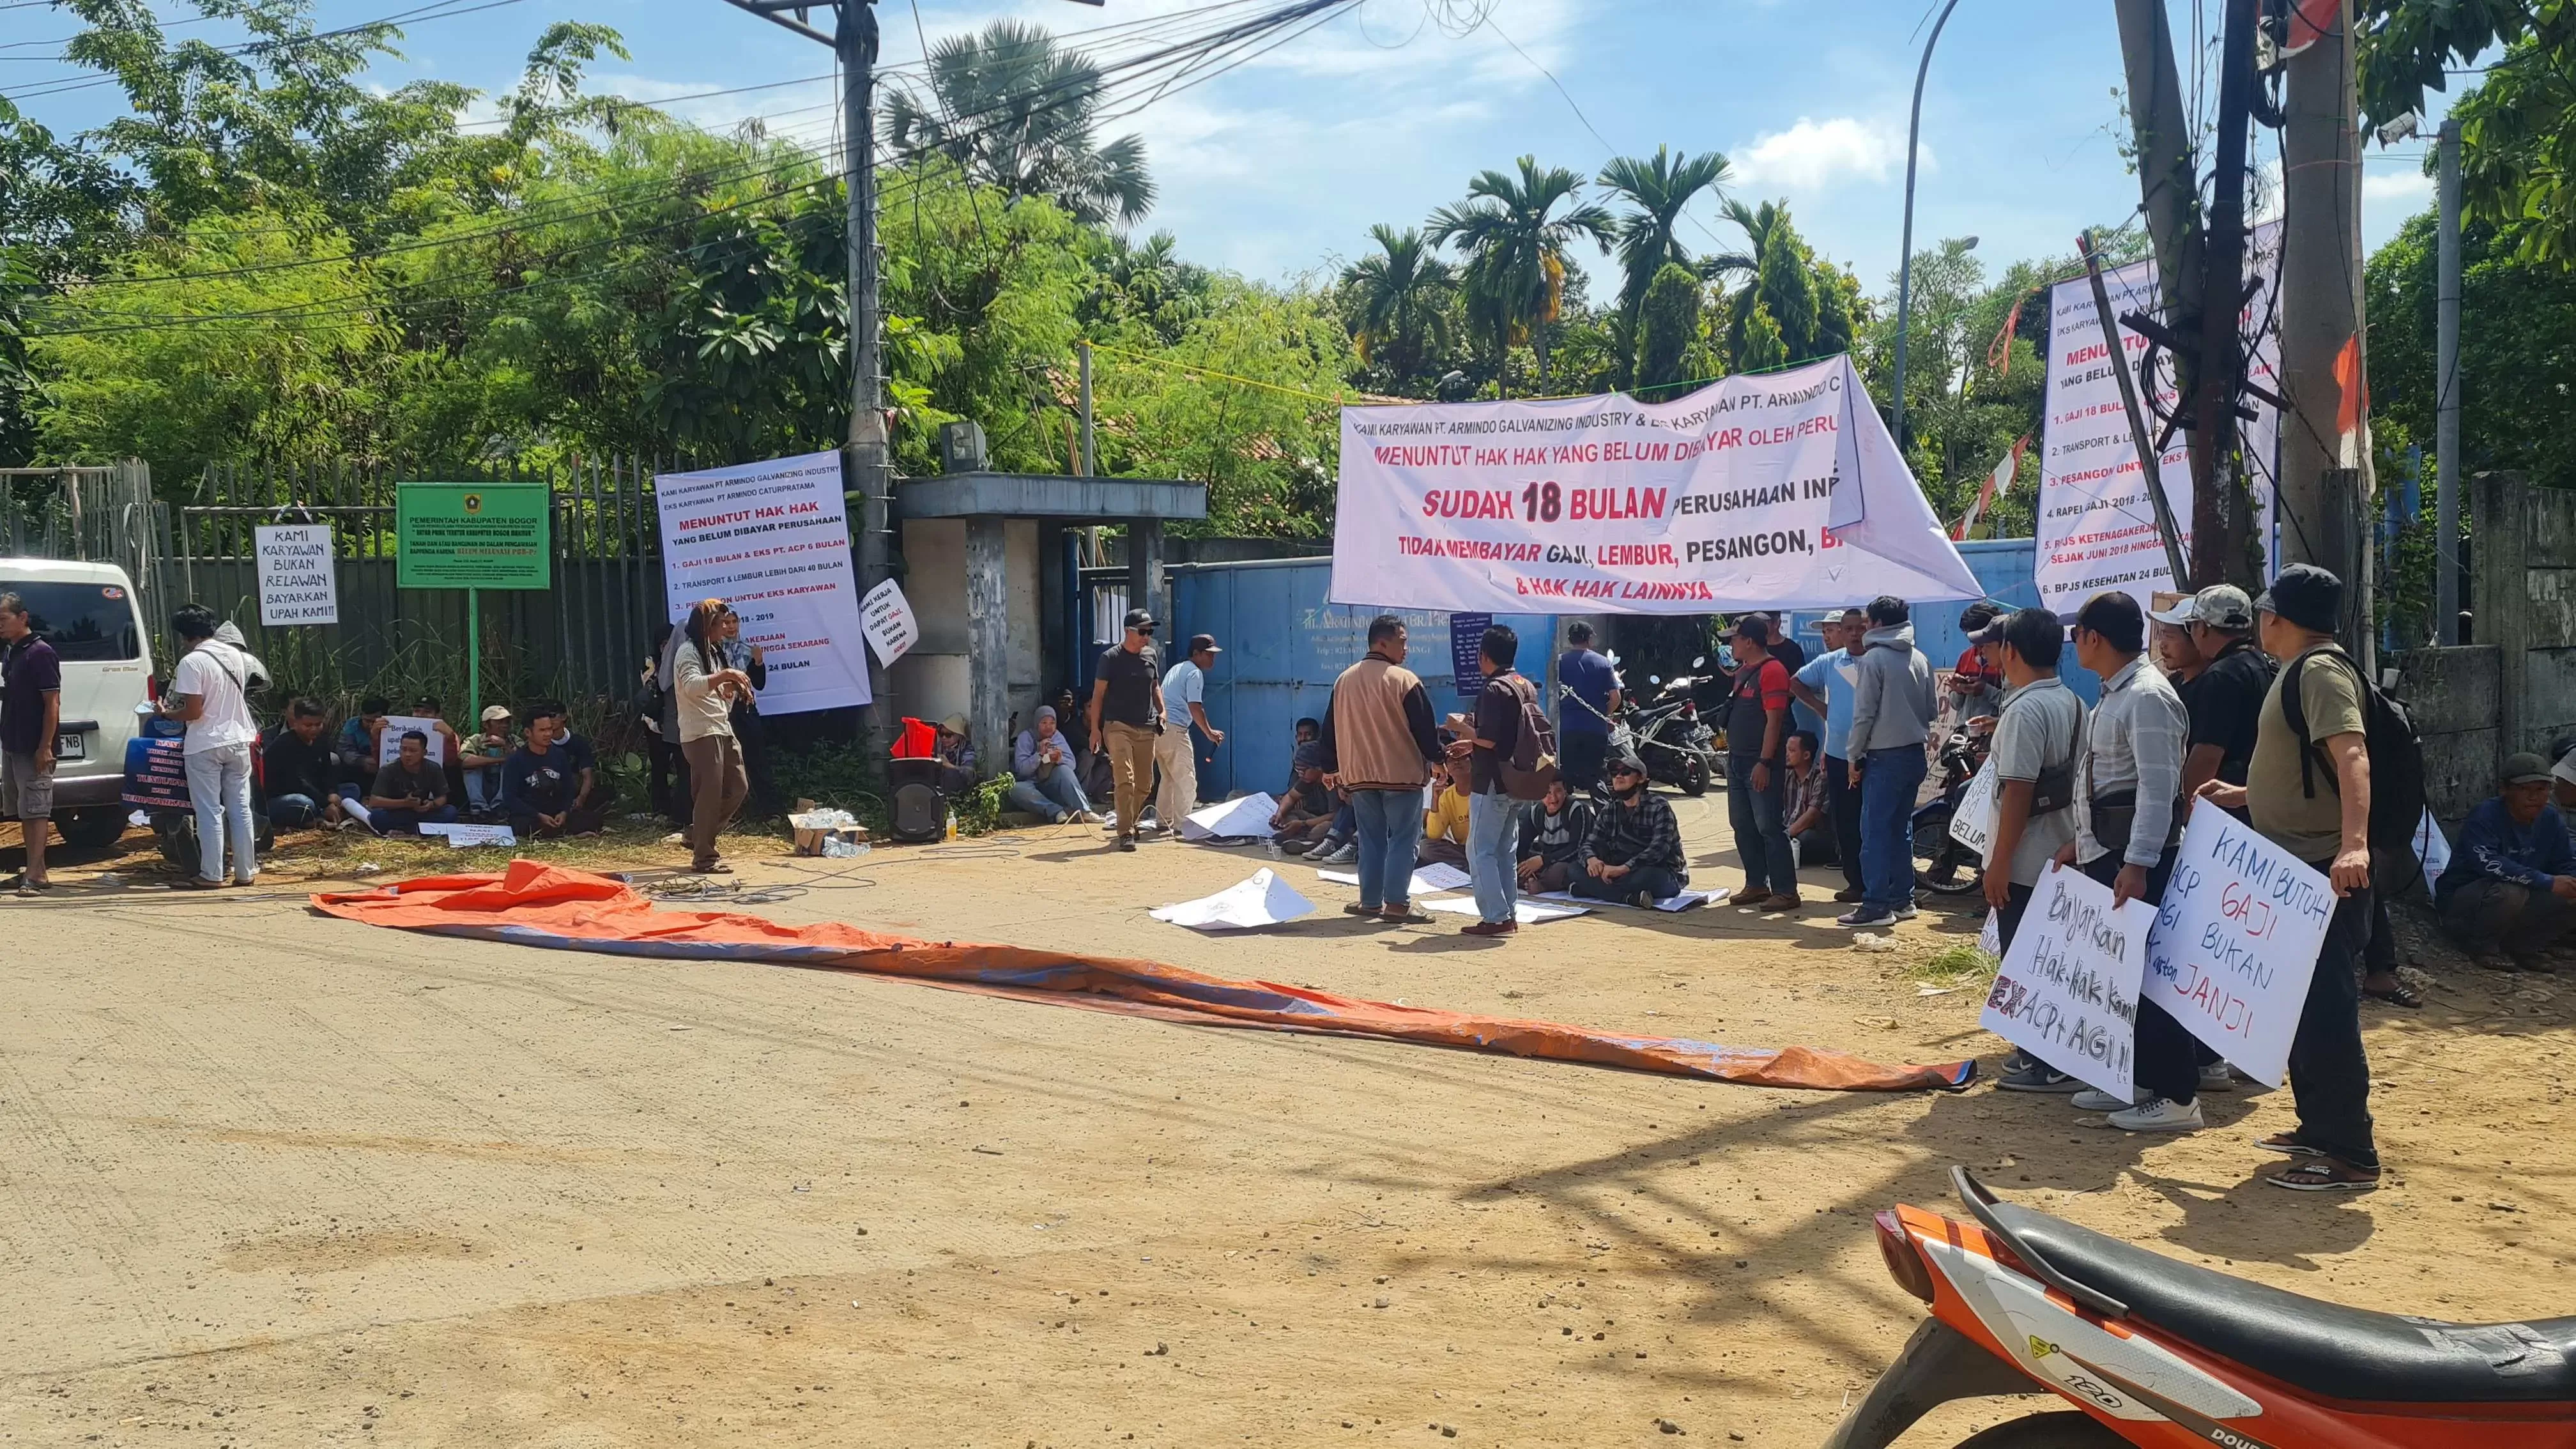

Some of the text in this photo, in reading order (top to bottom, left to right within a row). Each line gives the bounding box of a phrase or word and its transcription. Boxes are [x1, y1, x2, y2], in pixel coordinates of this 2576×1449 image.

[2066, 334, 2150, 366] MENUTU
[2061, 365, 2115, 390] YANG BELU
[1353, 420, 1378, 436] KAMI
[1379, 422, 1433, 436] KARYAWAN
[1436, 422, 1446, 434] PT.
[1448, 420, 1497, 435] ARMINDO
[1499, 417, 1573, 433] GALVANIZING
[1575, 413, 1632, 430] INDUSTRY
[1636, 413, 1646, 427] &
[1741, 395, 1763, 410] PT.
[1767, 381, 1827, 408] ARMINDO
[2054, 406, 2096, 425] 1. GAJI 18
[1374, 414, 1839, 467] MENUNTUT HAK HAK YANG BELUM DIBAYAR OLEH PERU
[2051, 434, 2119, 456] 2. TRANSPORT &
[661, 488, 677, 497] KAMI
[678, 484, 714, 495] KARYAWAN
[724, 476, 756, 487] ARMINDO
[757, 470, 804, 482] GALVANIZING
[804, 465, 840, 477] INDUSTRY
[2050, 477, 2058, 487] 3.
[2162, 451, 2181, 465] EKS
[664, 502, 678, 511] EKS
[678, 497, 714, 509] KARYAWAN
[726, 489, 758, 500] ARMINDO
[758, 482, 816, 496] CATURPRATAMA
[1422, 480, 1795, 523] SUDAH 18 BULAN PERUSAHAAN
[2112, 496, 2135, 508] 2018
[679, 501, 820, 531] MENUNTUT HAK HAK
[275, 530, 309, 542] KAMI
[672, 515, 842, 547] YANG BELUM DIBAYAR PERUSAHAAN
[263, 544, 325, 556] KARYAWAN
[682, 558, 702, 569] GAJI
[704, 556, 714, 565] 18
[716, 553, 742, 564] BULAN
[753, 549, 771, 557] EKS
[773, 546, 786, 555] PT.
[788, 544, 806, 553] ACP
[815, 538, 846, 549] BULAN
[1399, 536, 1446, 557] TIDAK
[1446, 539, 1542, 562] MEMBAYAR
[1546, 545, 1595, 569] GAJI,
[1598, 544, 1679, 569] LEMBUR,
[1687, 529, 1814, 564] PESANGON,
[2044, 540, 2051, 550] 5.
[2050, 537, 2165, 564] SEJAK JUNI 2018 HINGGA
[273, 559, 315, 571] BUKAN
[682, 576, 726, 590] TRANSPORT
[733, 571, 764, 582] LEMBUR
[765, 567, 787, 577] LEBIH
[788, 564, 807, 574] DARI
[808, 564, 816, 572] 40
[818, 560, 844, 571] BULAN
[266, 573, 328, 587] RELAWAN
[735, 592, 765, 602] UNTUK
[767, 589, 785, 598] EKS
[787, 582, 836, 595] KARYAWAN
[1516, 577, 1714, 602] & HAK HAK LAINNYA
[2043, 569, 2150, 594] 6. BPJS KESEHATAN 24
[266, 591, 328, 604] BAYARKAN
[860, 587, 893, 613] KAMI KERJA
[870, 601, 891, 617] UNTUK
[270, 605, 334, 619] UPAH KAMI!!
[756, 612, 774, 622] 2019
[869, 616, 889, 631] DAPAT
[882, 620, 902, 636] BUKAN
[885, 630, 907, 647] KARENA
[761, 638, 830, 653] INGGA SEKARANG
[781, 659, 811, 670] BULAN
[2168, 857, 2200, 900] ACP
[2212, 826, 2331, 930] KAMI BUTUH
[2046, 880, 2126, 964] Bayarkan
[2158, 894, 2182, 931] AGI
[2221, 882, 2278, 940] GAJI
[2201, 922, 2274, 990] BUKAN
[2174, 963, 2253, 1039] JANJI
[2064, 1374, 2123, 1409] 120
